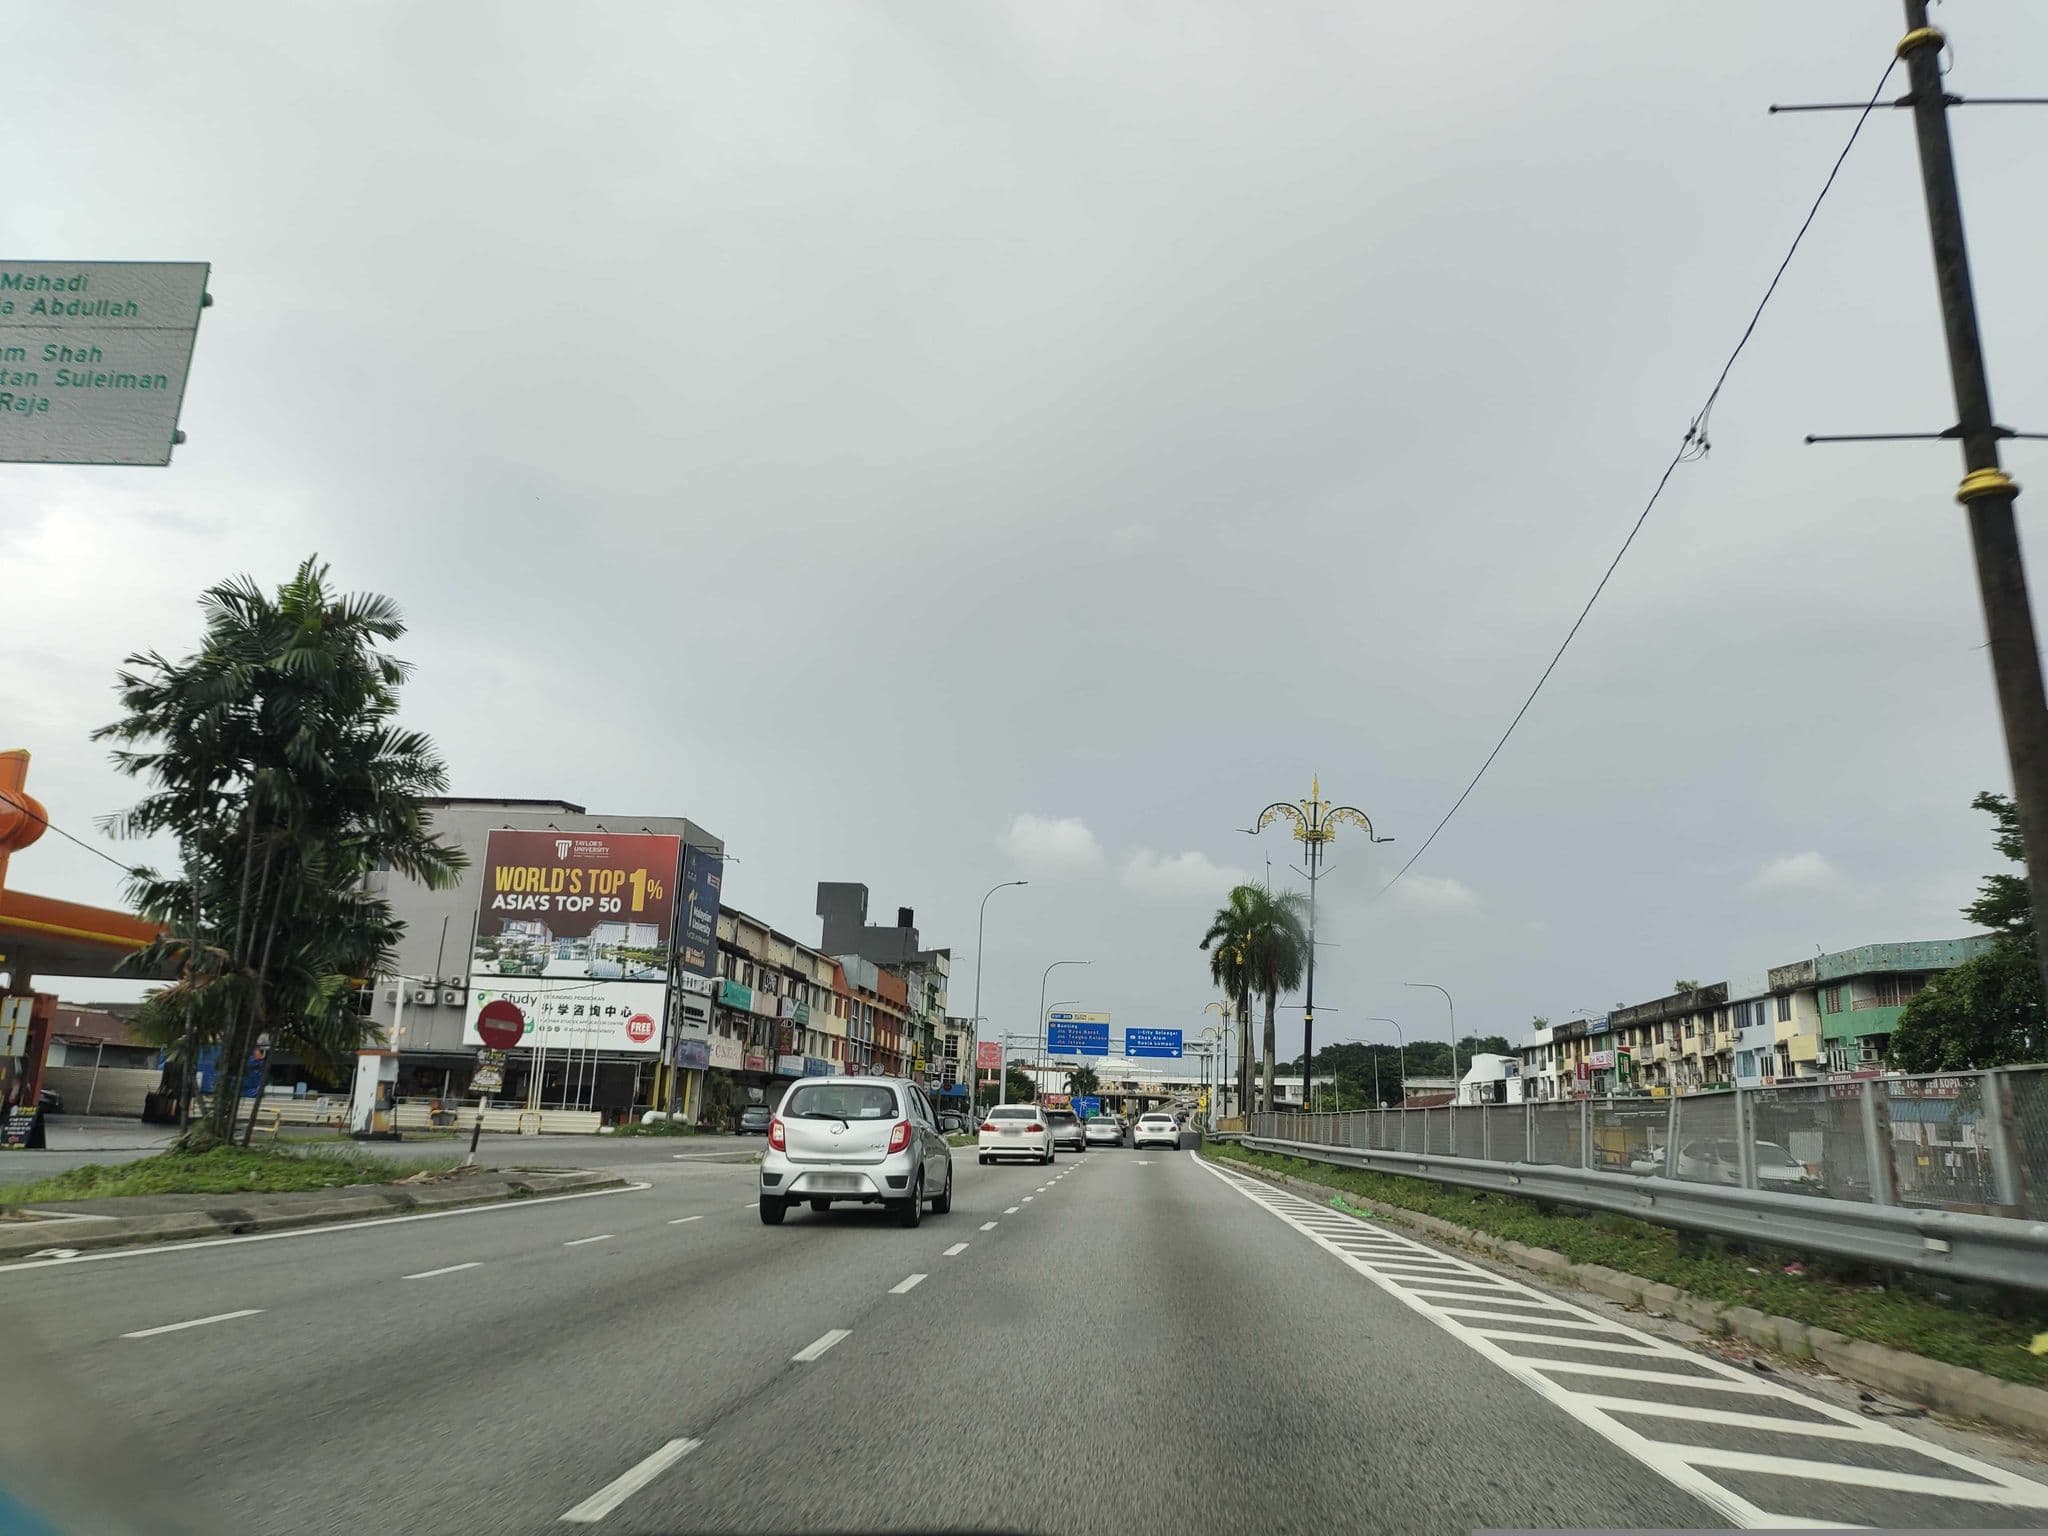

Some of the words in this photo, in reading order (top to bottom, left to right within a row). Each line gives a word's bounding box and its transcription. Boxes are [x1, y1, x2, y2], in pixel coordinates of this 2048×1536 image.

[1, 273, 88, 292] Mahadi
[29, 298, 139, 317] Abdullah
[0, 348, 26, 362] m
[41, 344, 103, 363] Shah
[55, 369, 168, 389] Suleiman
[0, 392, 50, 416] Raja
[495, 866, 583, 894] WORLD'S
[588, 868, 626, 895] TOP
[491, 894, 551, 911] ASIA'S
[555, 896, 594, 912] TOP
[599, 897, 622, 913] 50
[501, 993, 538, 1007] Study
[630, 1022, 651, 1032] FREE
